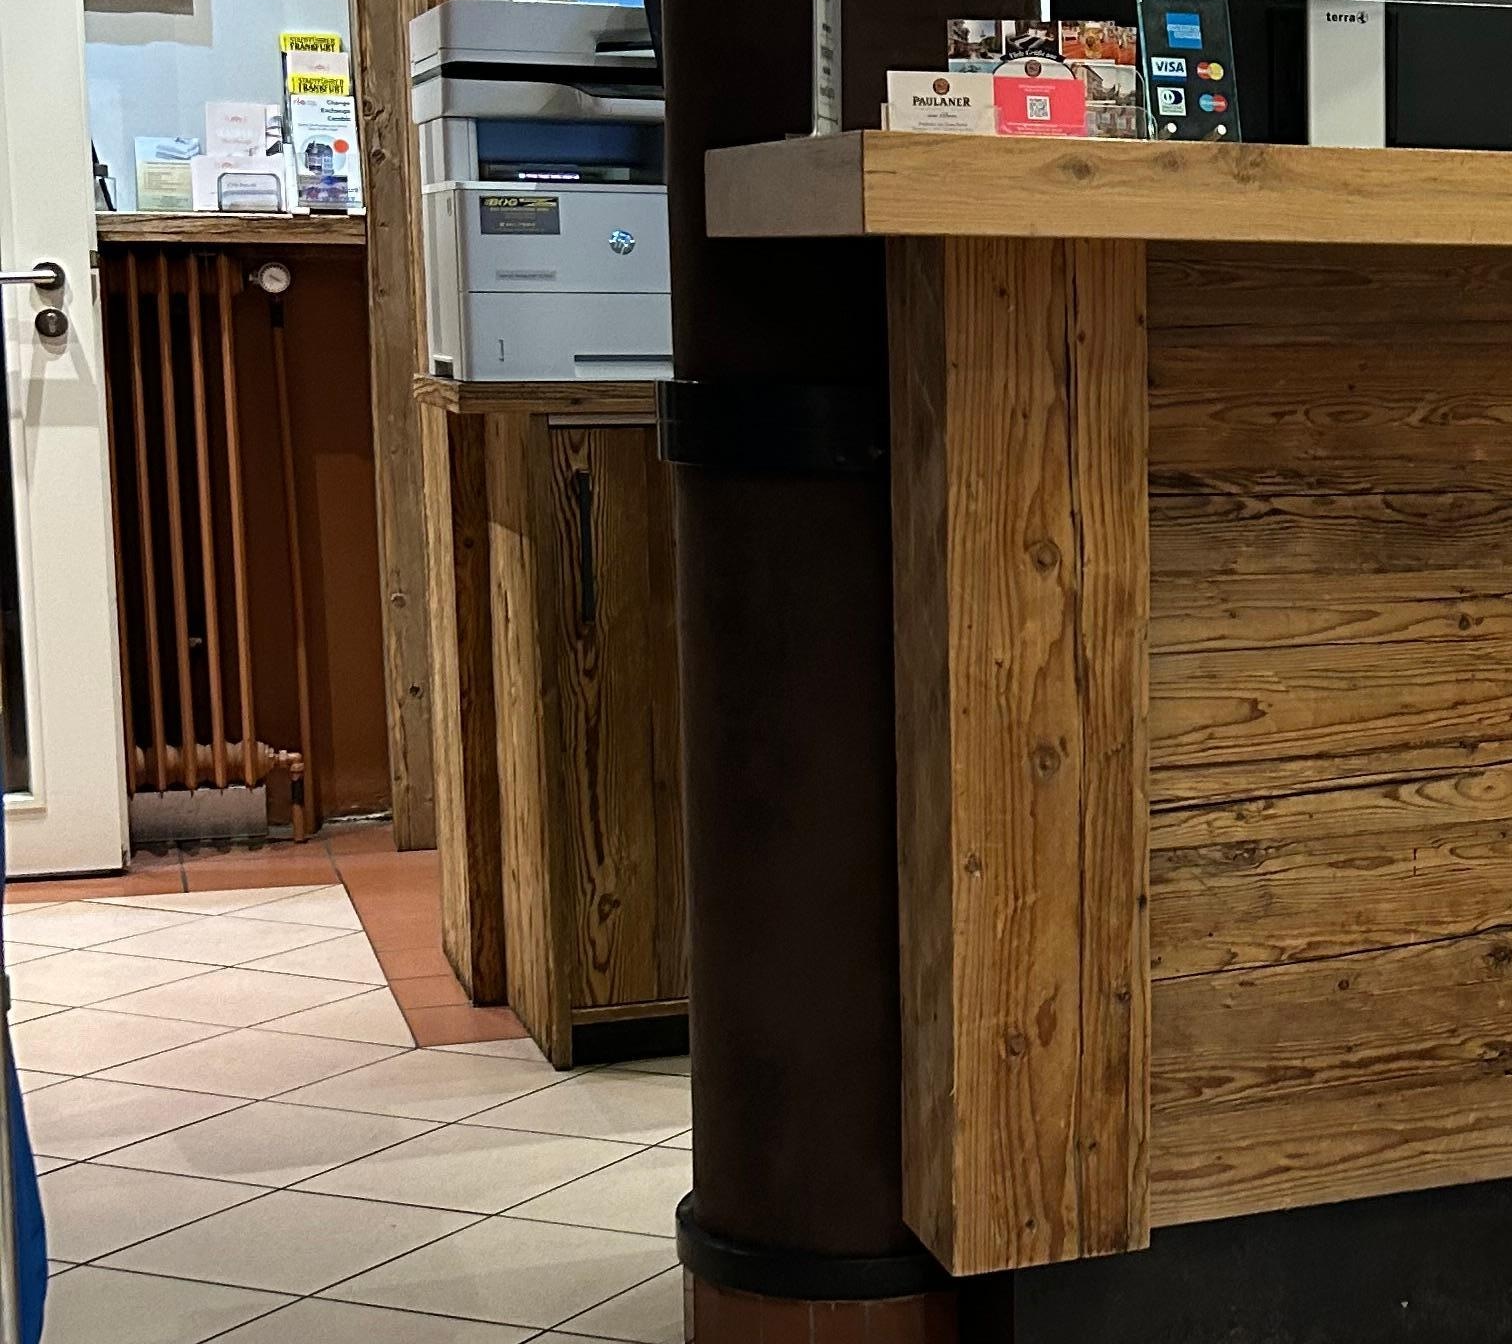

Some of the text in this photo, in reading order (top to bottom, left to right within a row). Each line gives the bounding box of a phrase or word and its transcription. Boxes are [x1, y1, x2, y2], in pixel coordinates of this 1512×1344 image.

[1326, 11, 1356, 23] terra
[1156, 60, 1185, 73] VISA
[912, 95, 971, 107] PAULANER
